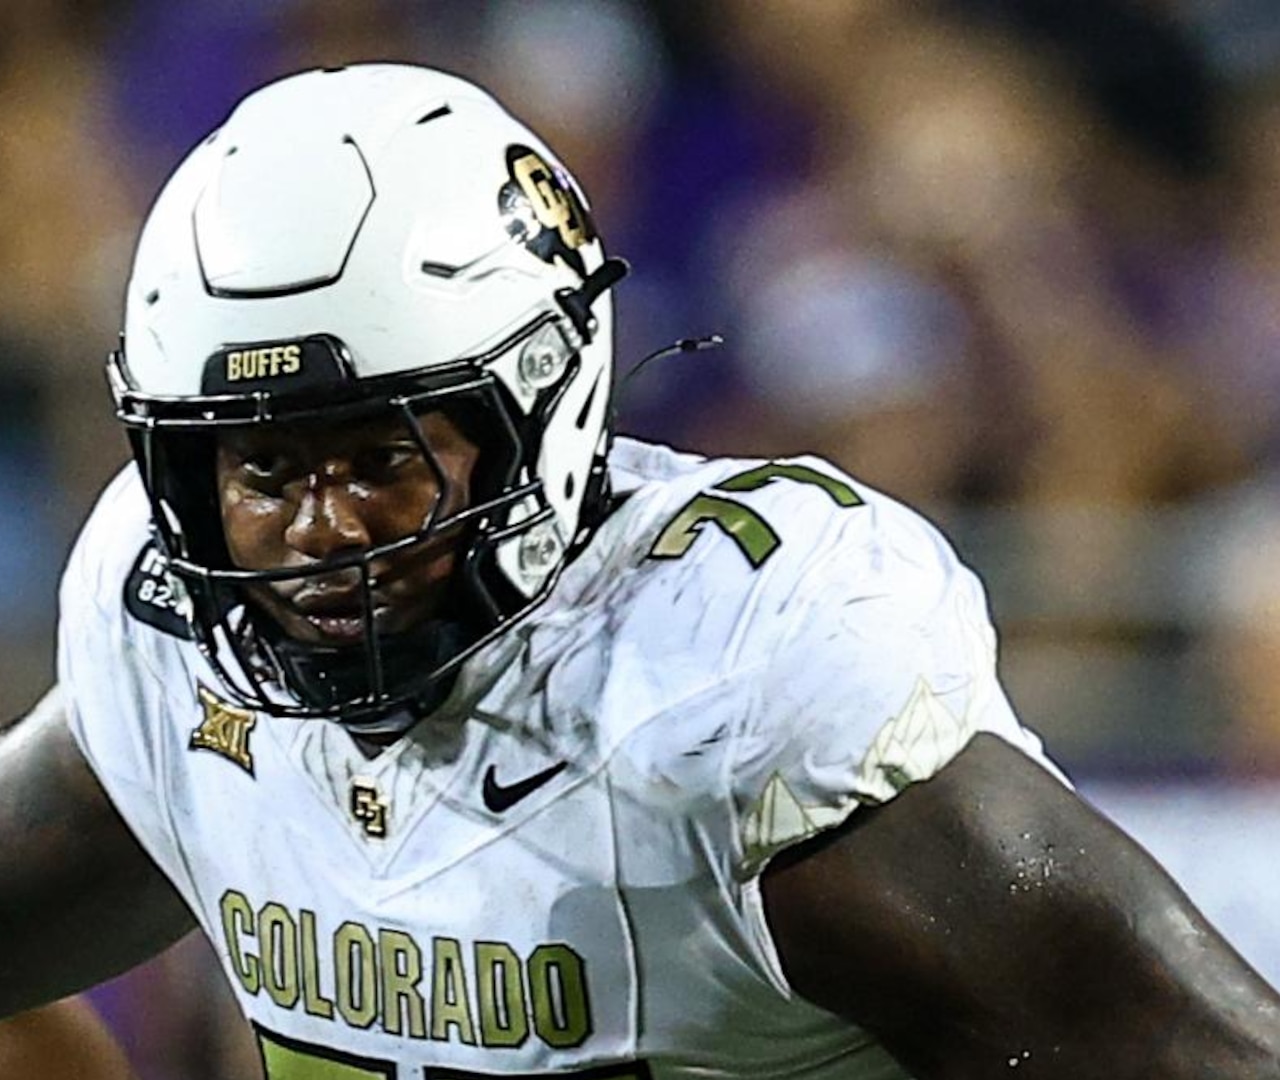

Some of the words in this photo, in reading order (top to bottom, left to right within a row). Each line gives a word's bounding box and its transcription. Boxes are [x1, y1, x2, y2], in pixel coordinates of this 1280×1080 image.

[227, 344, 301, 381] BUFFS
[646, 461, 866, 569] 77
[220, 888, 593, 1048] COLORADO
